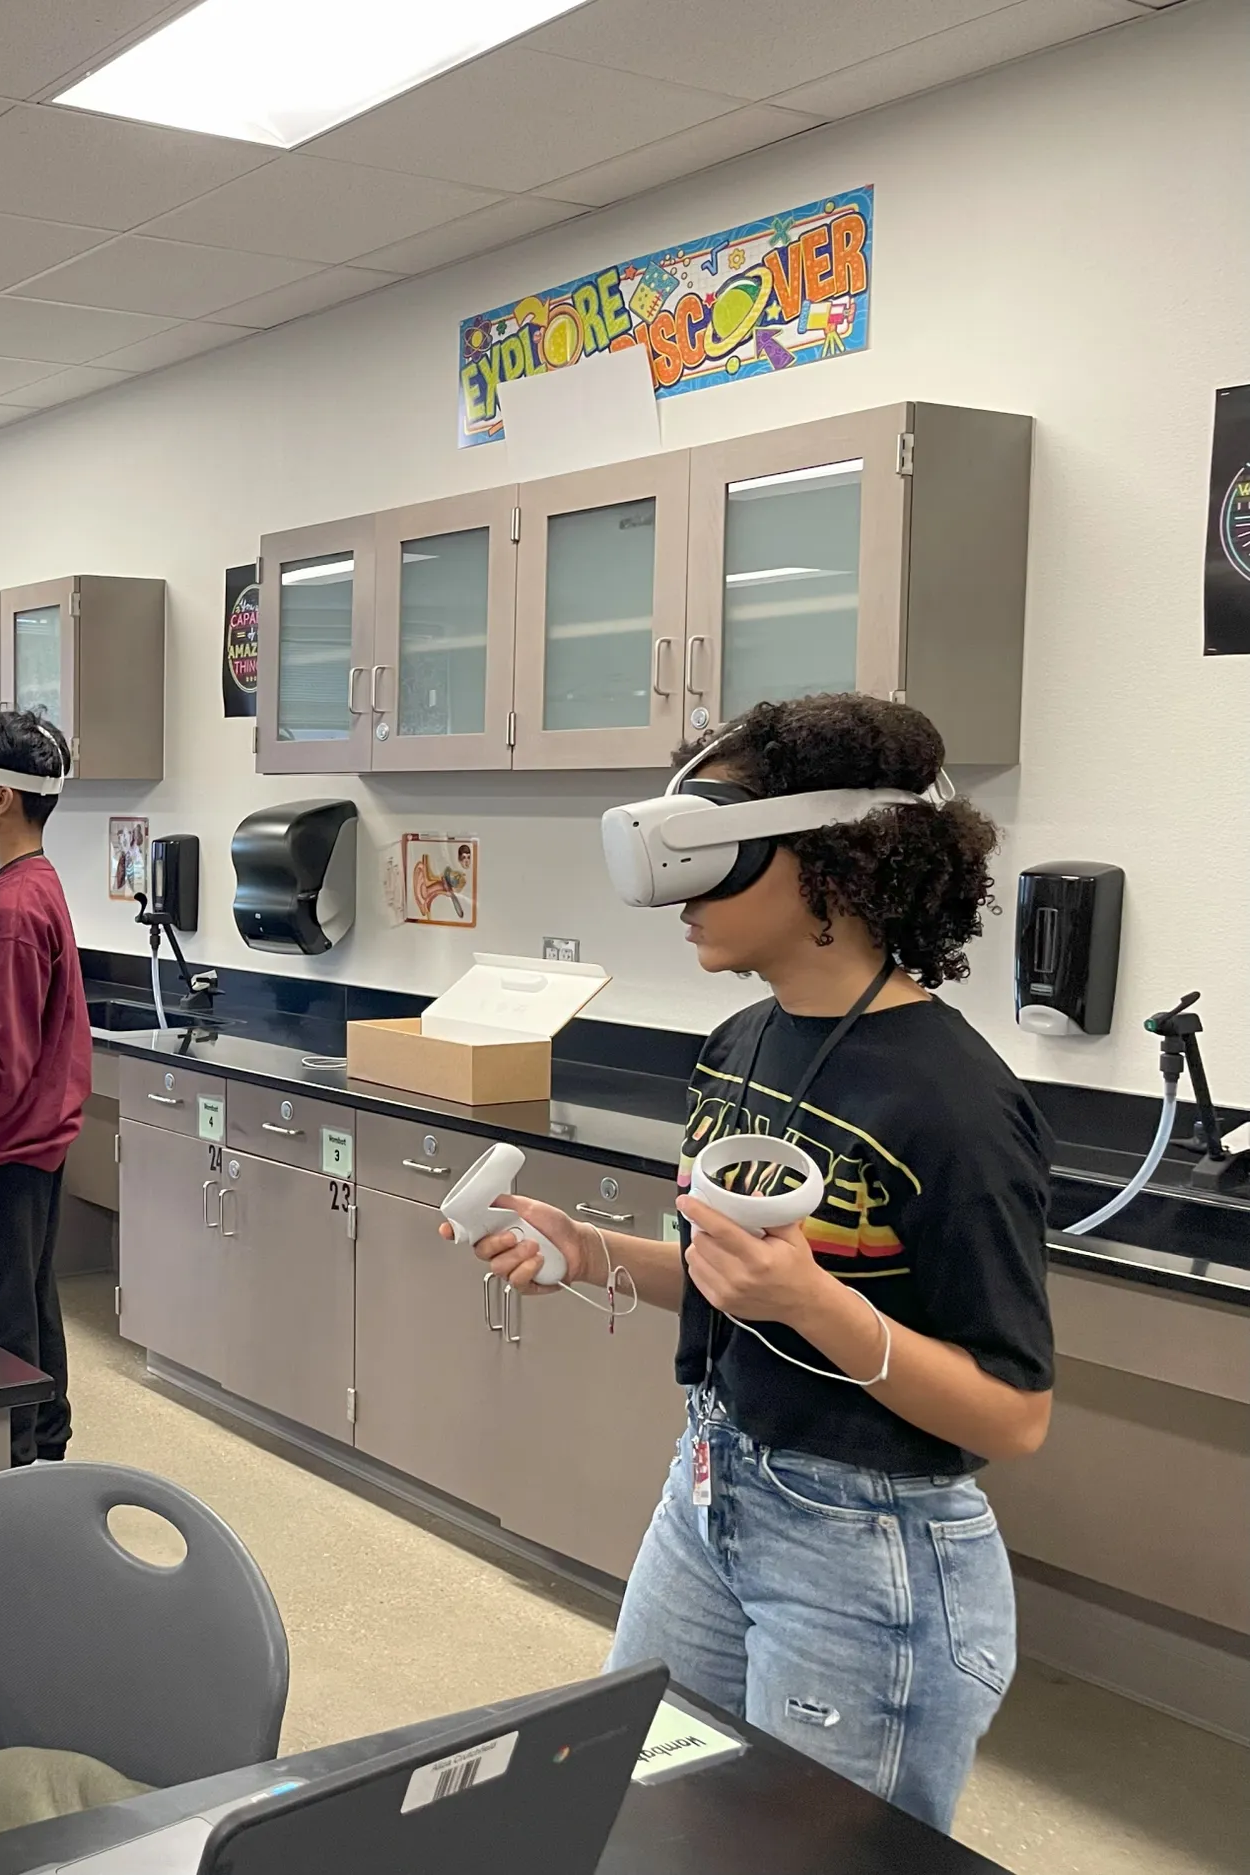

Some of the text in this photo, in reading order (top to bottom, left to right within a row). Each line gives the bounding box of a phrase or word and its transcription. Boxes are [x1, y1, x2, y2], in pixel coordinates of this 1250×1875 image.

[208, 1116, 214, 1127] 4
[208, 1144, 223, 1173] 24
[335, 1149, 340, 1161] 3
[329, 1181, 351, 1212] 23
